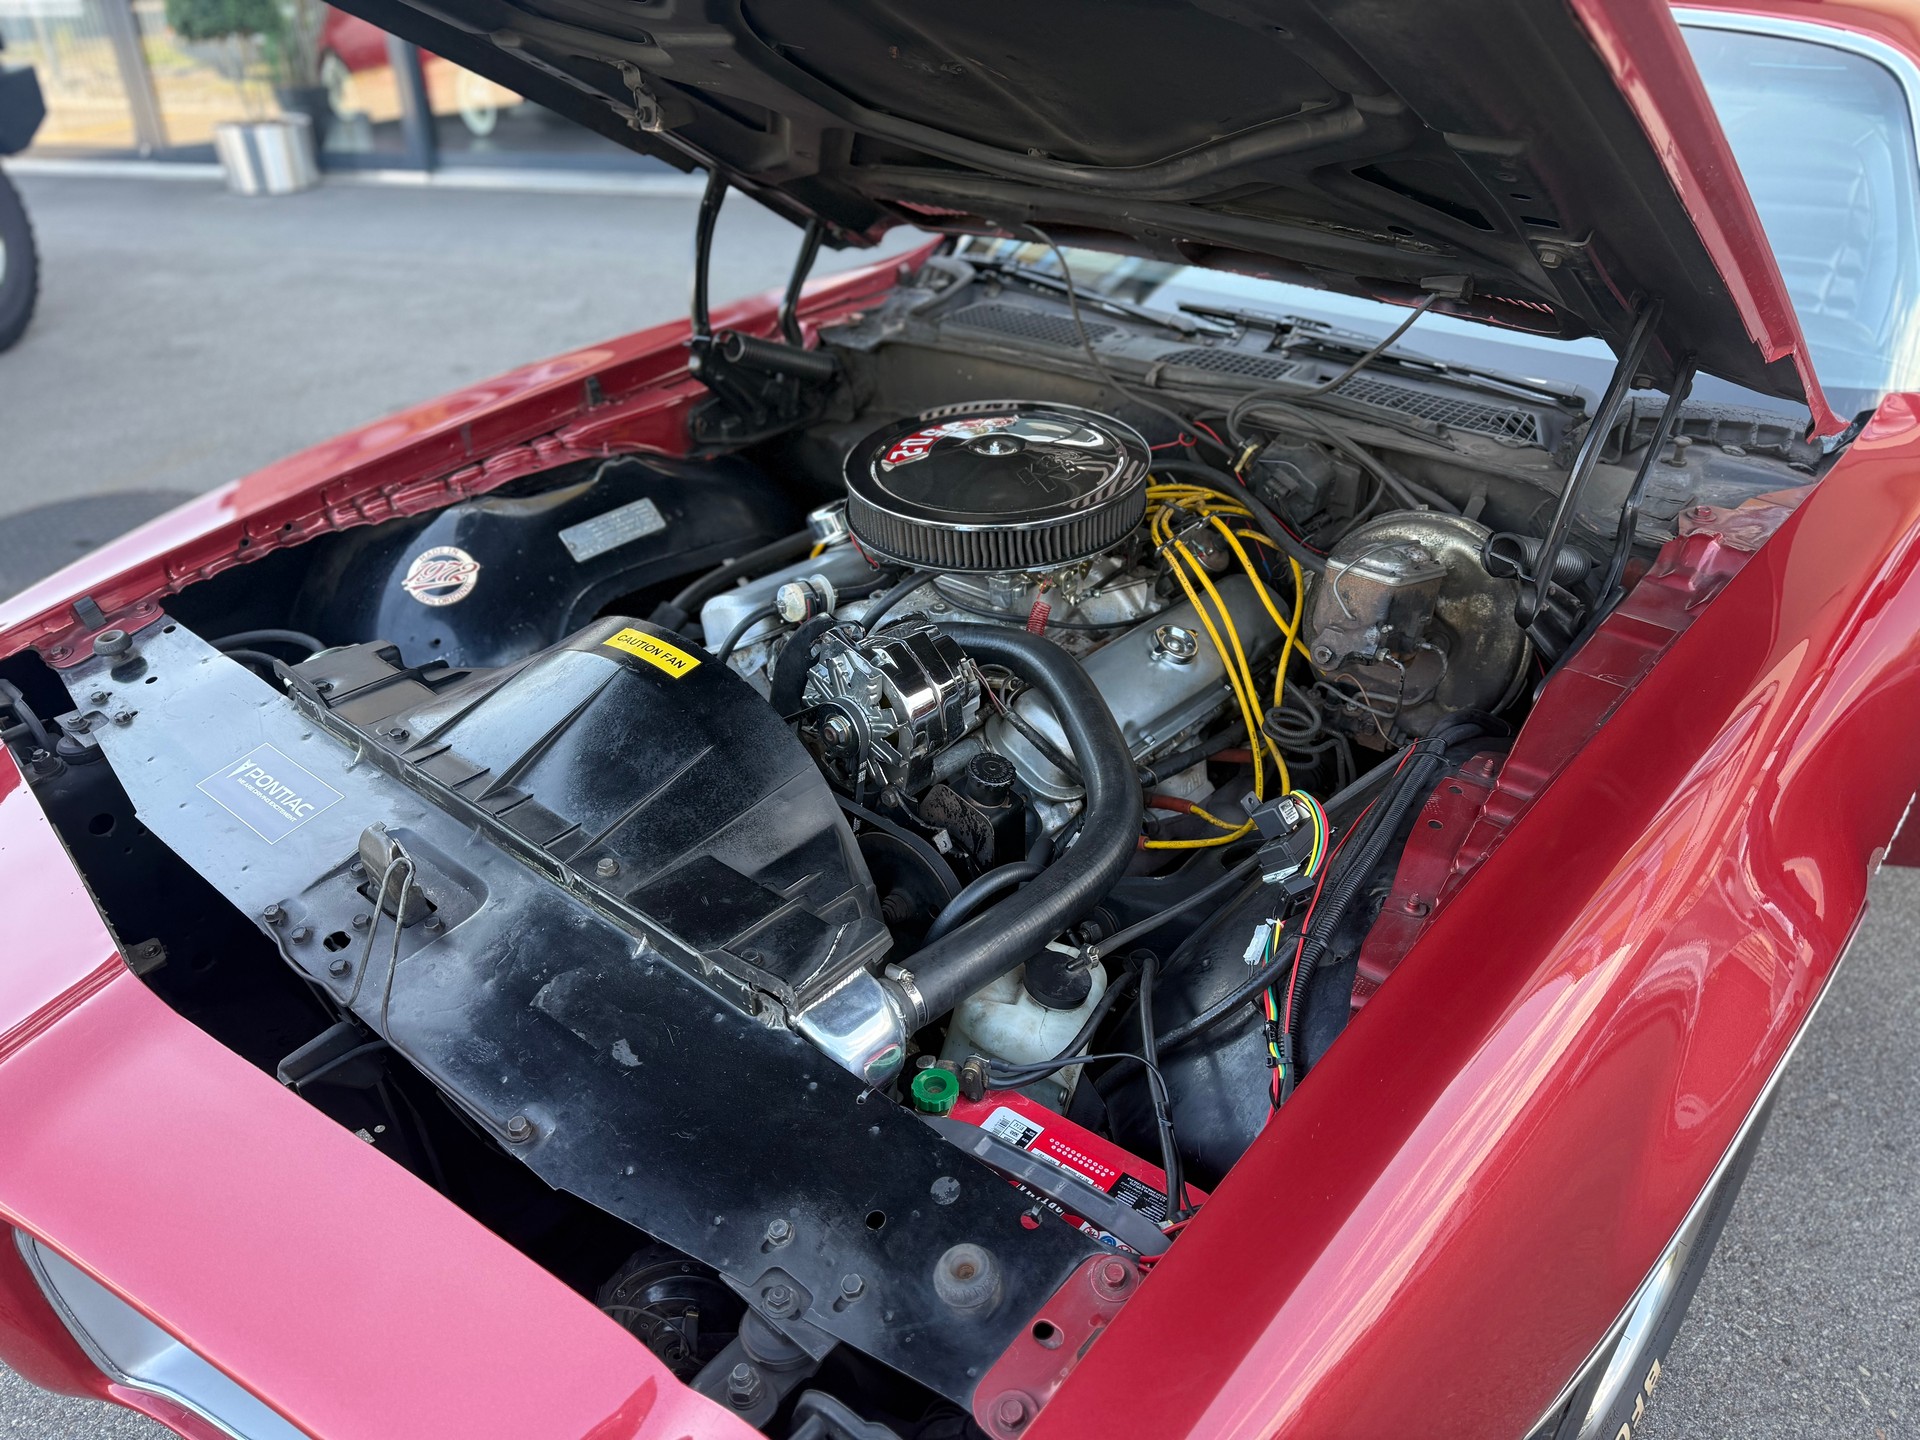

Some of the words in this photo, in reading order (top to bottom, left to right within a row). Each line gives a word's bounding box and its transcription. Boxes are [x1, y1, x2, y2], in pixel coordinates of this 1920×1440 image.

[403, 561, 479, 584] 1972
[617, 634, 663, 656] CAUTION
[660, 652, 687, 669] FAN
[244, 767, 315, 818] PONTIAC
